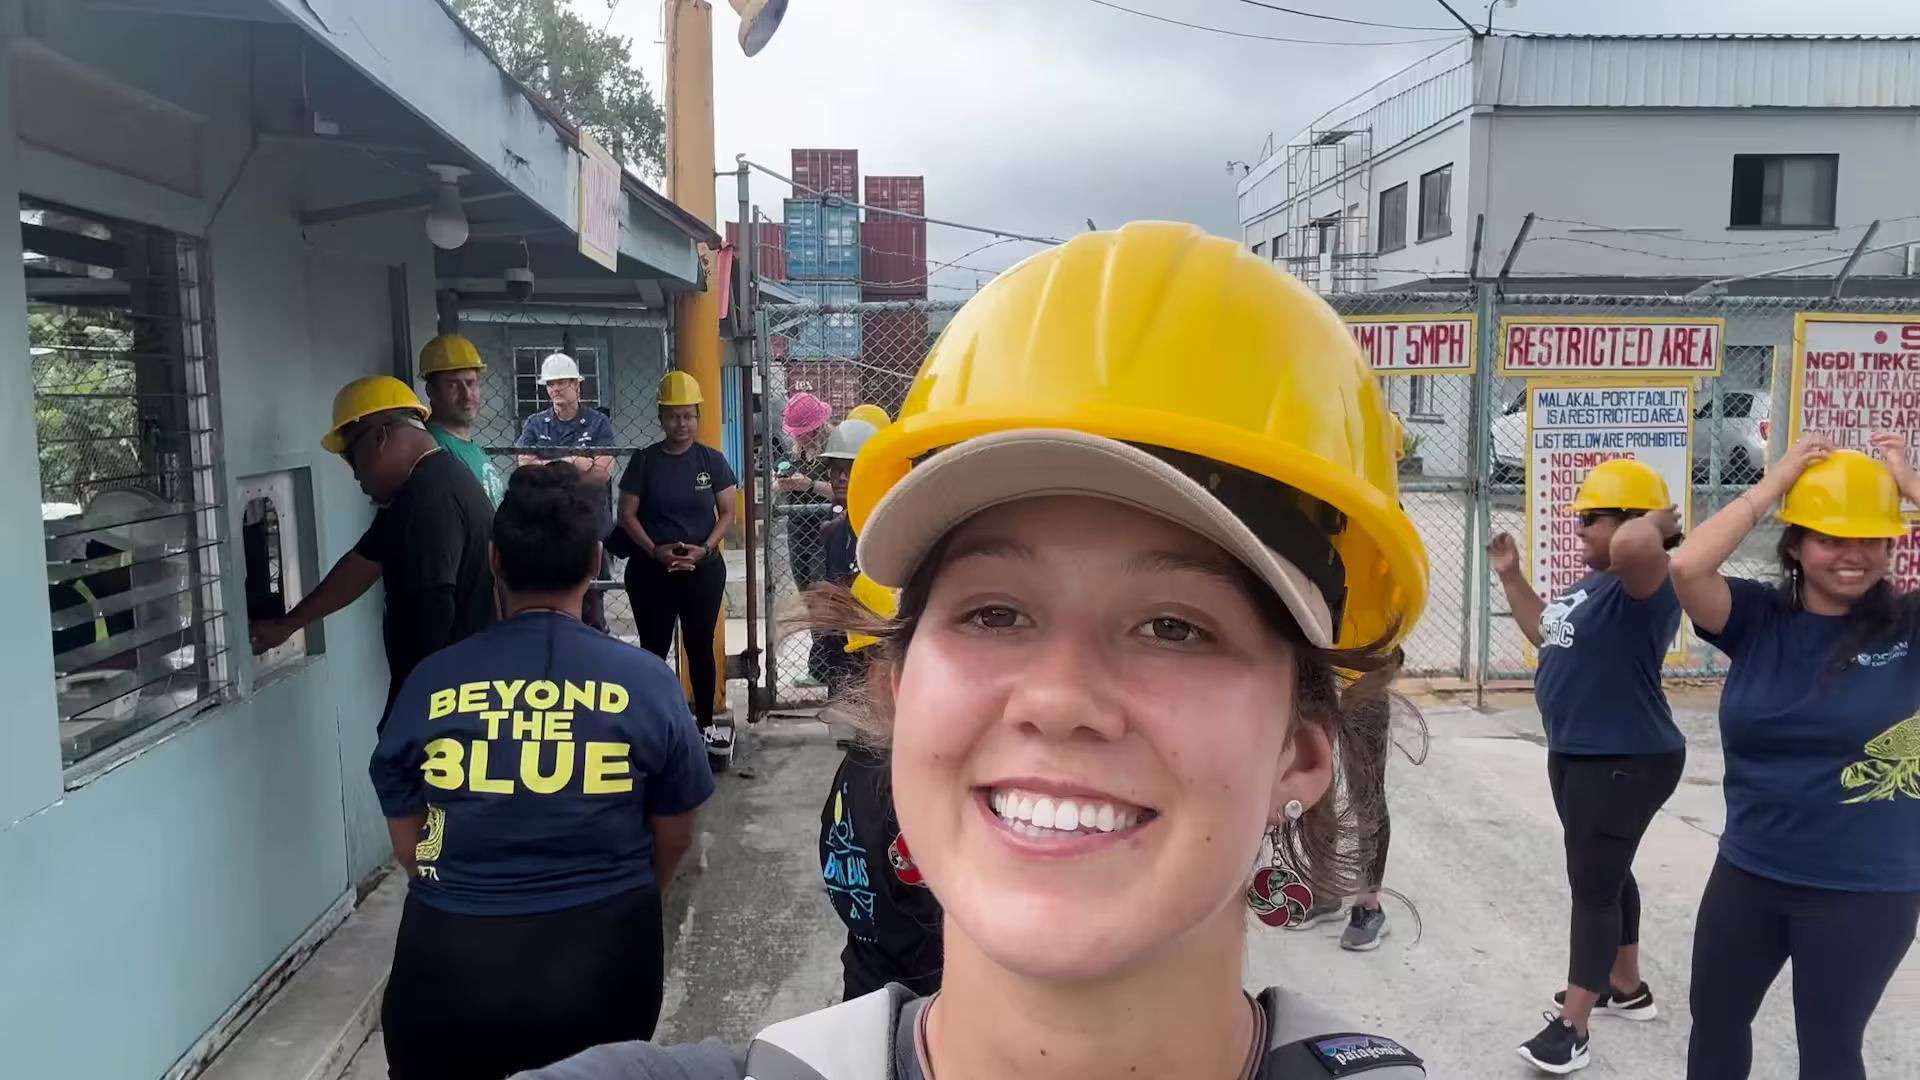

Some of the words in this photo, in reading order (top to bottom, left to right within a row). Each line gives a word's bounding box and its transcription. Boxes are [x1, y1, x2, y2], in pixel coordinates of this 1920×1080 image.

[1406, 324, 1464, 365] 5MPH
[1508, 326, 1653, 366] RESTRICTED
[1659, 327, 1713, 367] AREA
[1806, 351, 1855, 370] NGDI
[1538, 391, 1599, 408] MALAKAL
[1601, 391, 1637, 407] PORT
[1638, 390, 1687, 407] FACILITY
[1804, 390, 1852, 408] ONLY
[1547, 409, 1557, 425] IS
[1559, 409, 1567, 424] A
[1569, 408, 1649, 424] RESTRICTED
[1650, 408, 1685, 424] AREA
[1804, 409, 1893, 428] VEHICLES
[1535, 433, 1561, 449] LIST
[1563, 432, 1600, 448] BELOW
[1602, 432, 1624, 448] ARE
[1626, 431, 1687, 448] PROHIBITED
[1551, 453, 1572, 468] NO
[1551, 469, 1572, 484] NO
[1551, 487, 1572, 501] NO
[1551, 520, 1572, 535] NO
[1551, 537, 1572, 552] NO
[1551, 554, 1572, 569] NO
[1551, 570, 1572, 585] NO
[428, 679, 630, 720] BEYOND
[480, 711, 574, 740] THE
[420, 738, 633, 794] BLUE
[1335, 1045, 1406, 1066] patagonia
